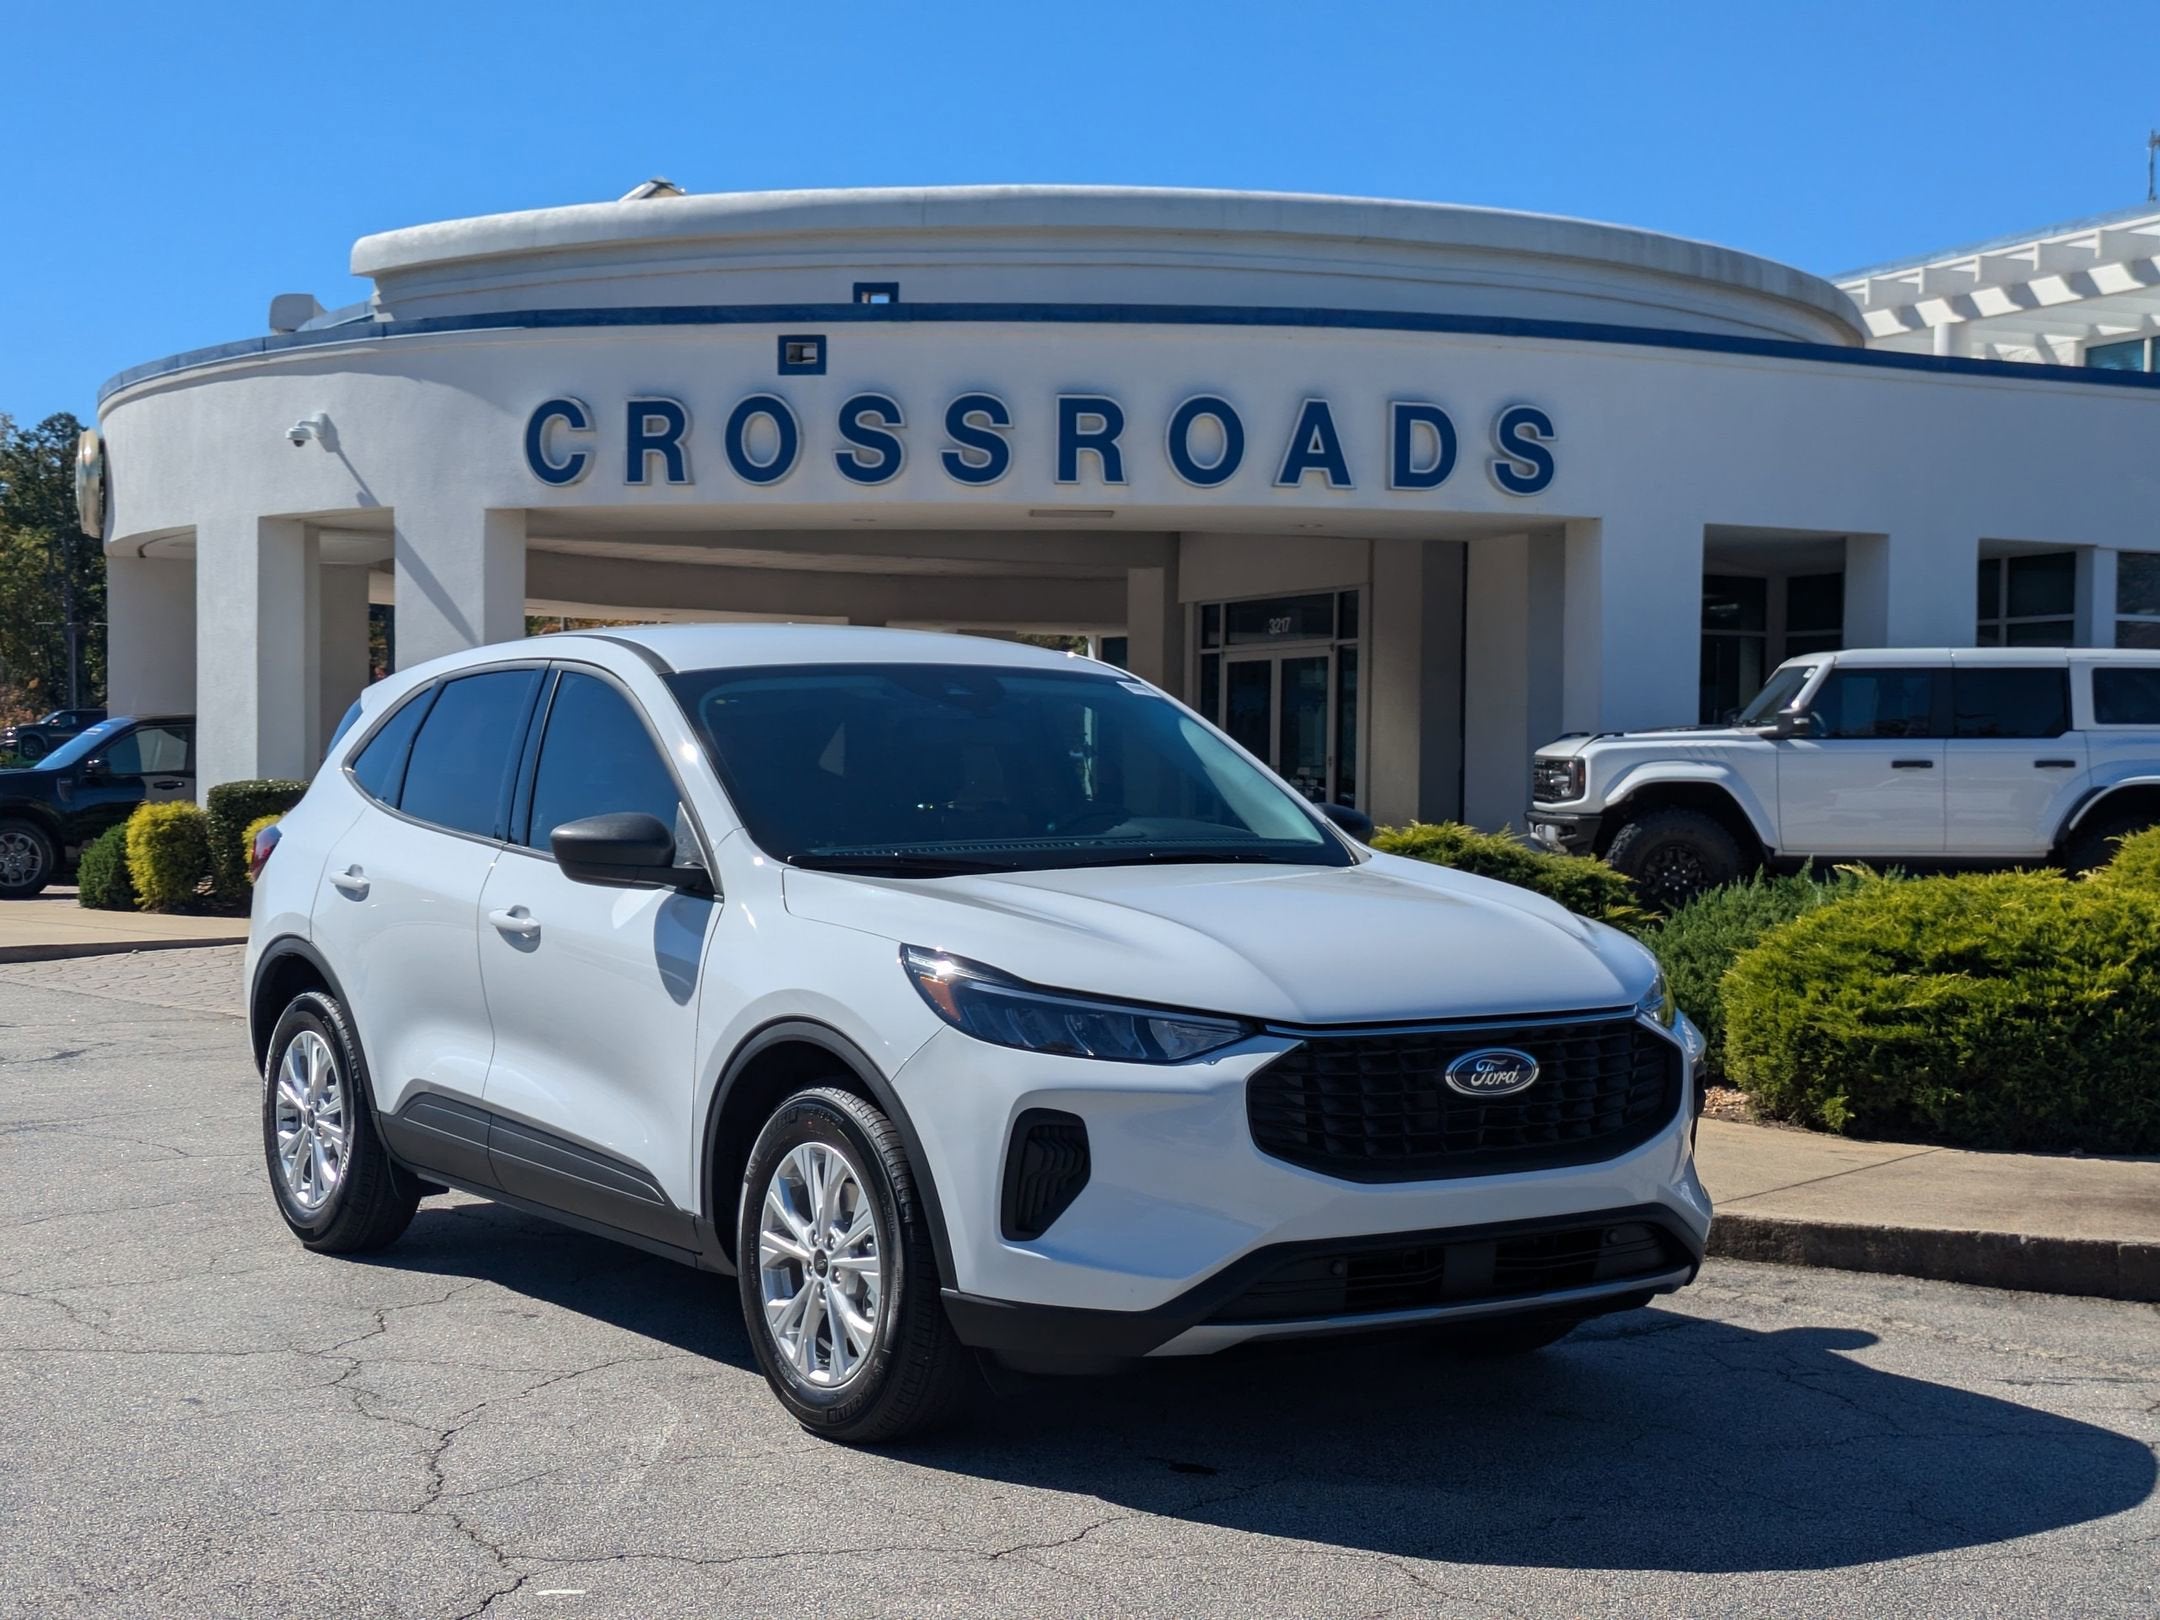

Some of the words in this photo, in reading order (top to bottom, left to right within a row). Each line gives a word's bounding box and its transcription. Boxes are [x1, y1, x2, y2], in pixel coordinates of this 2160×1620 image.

[524, 392, 1558, 496] CROSSROADS
[1268, 616, 1292, 635] 3217
[1471, 1059, 1520, 1086] Ford
